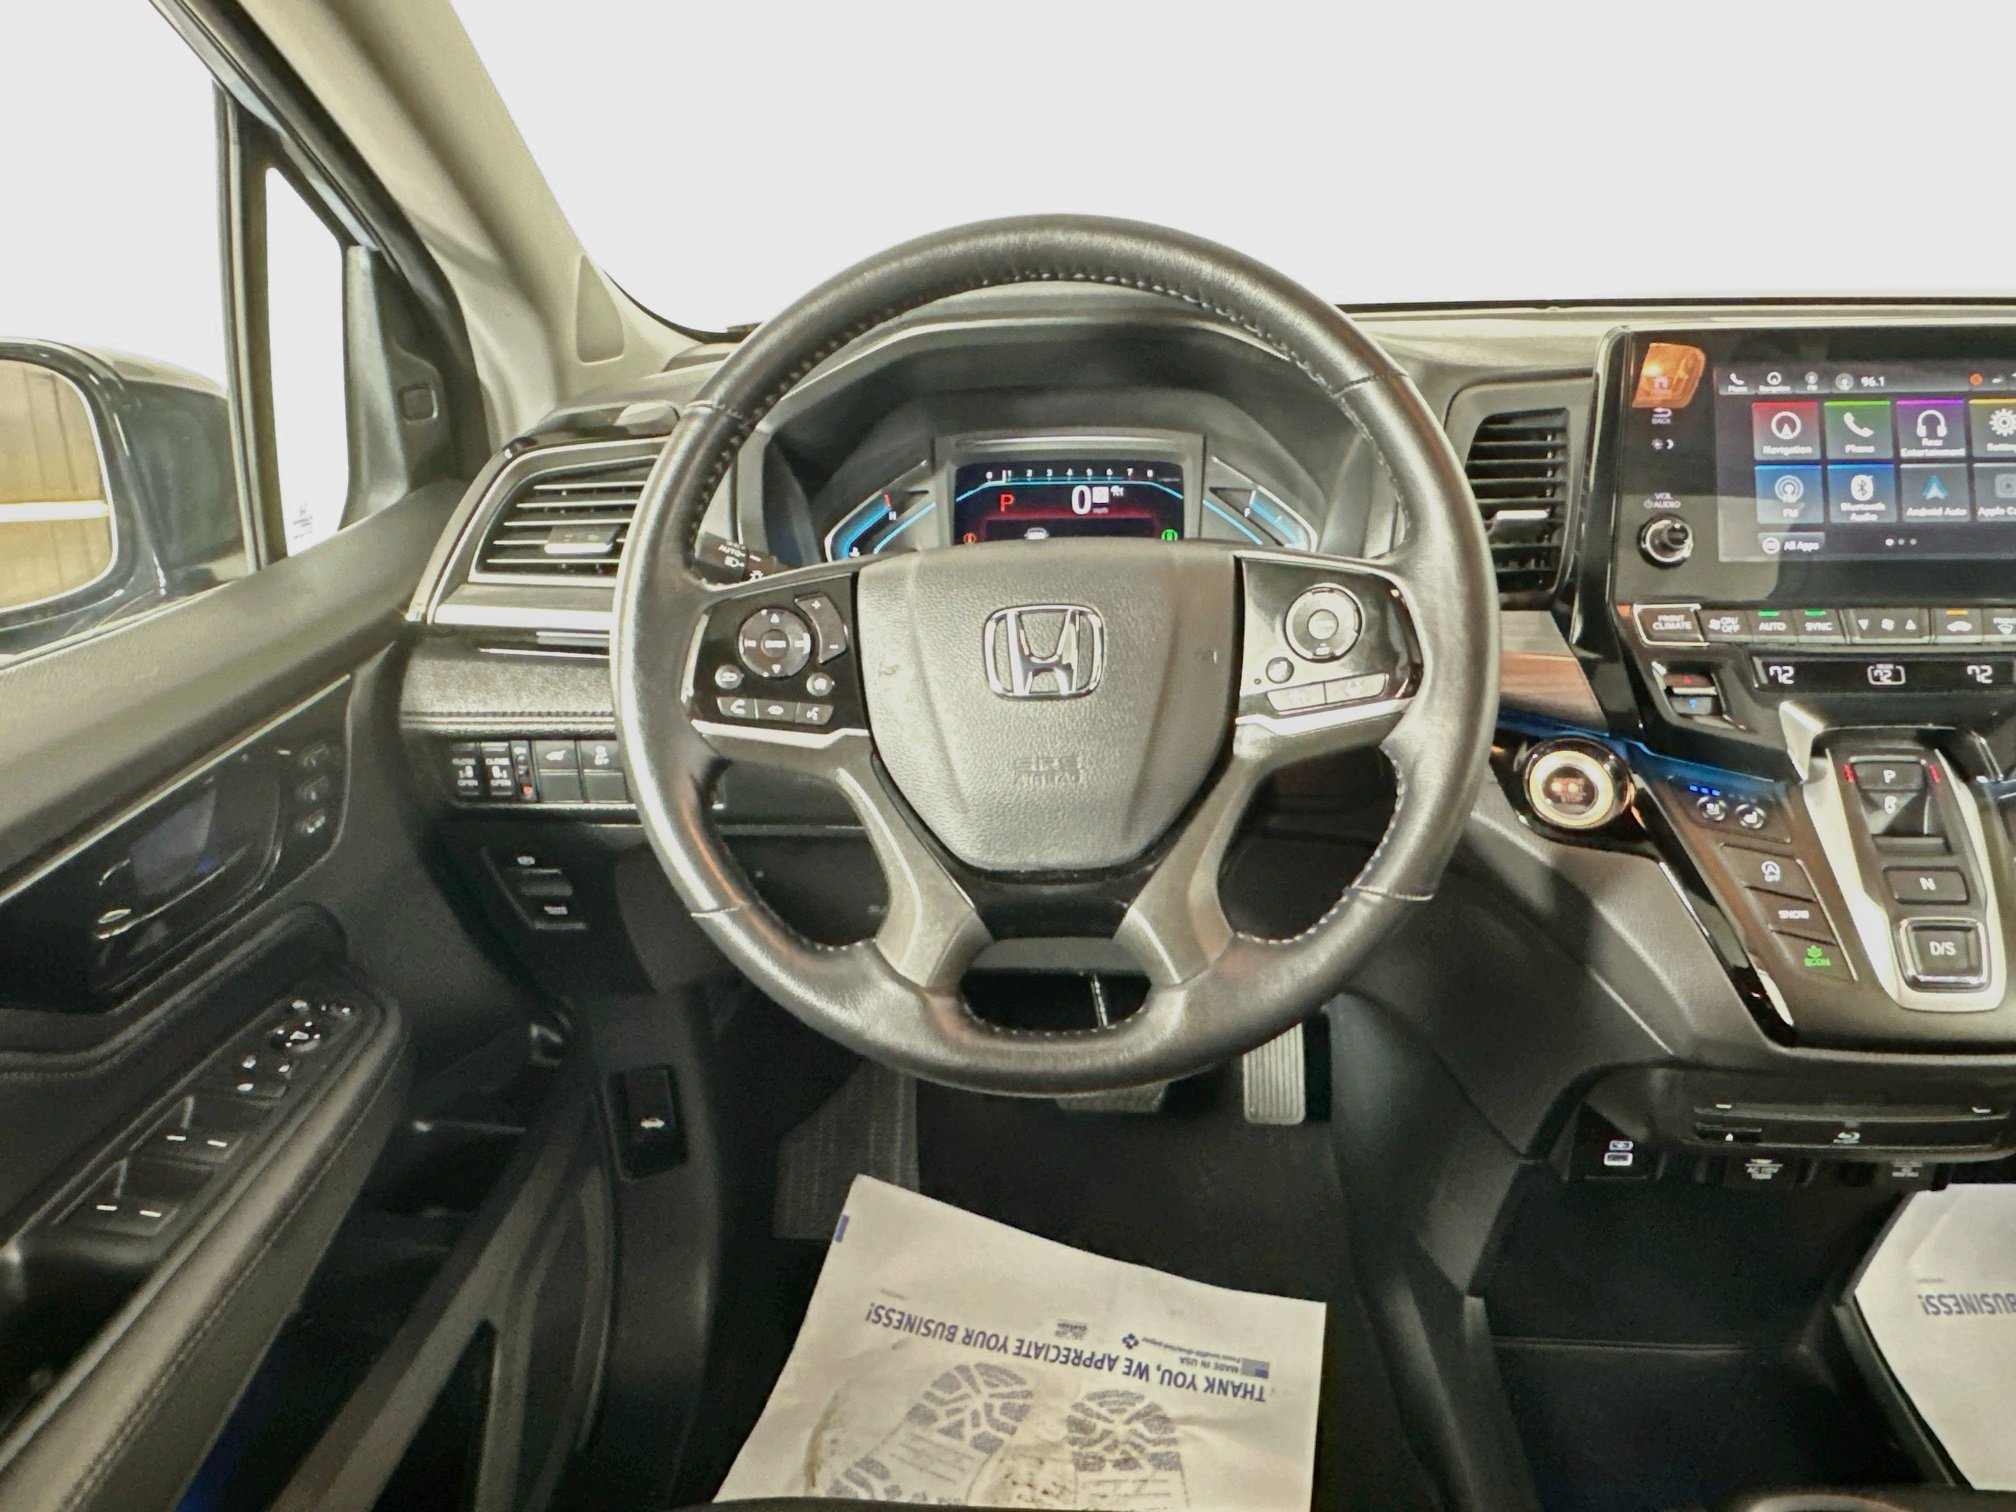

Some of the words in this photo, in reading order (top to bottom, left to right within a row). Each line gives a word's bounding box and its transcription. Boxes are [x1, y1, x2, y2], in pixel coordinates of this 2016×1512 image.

[1861, 376, 1885, 387] 96.1
[1762, 445, 1812, 455] Navigation
[1845, 444, 1875, 453] Phone
[1901, 447, 1965, 457] Entertainment
[1000, 493, 1015, 512] P
[1071, 485, 1092, 515] 0
[1653, 501, 1682, 509] AUDIO
[1840, 502, 1886, 511] Bluetooth
[1906, 507, 1943, 516] Android
[1944, 507, 1967, 516] Auto
[1977, 507, 2005, 517] Apple
[1850, 513, 1878, 521] Audio
[1784, 541, 1796, 551] All
[1797, 541, 1820, 552] Apps
[1652, 622, 1692, 630] CLIMATE
[1758, 622, 1786, 631] AUTO
[1804, 621, 1834, 631] SYNC
[1769, 665, 1795, 685] 72
[1967, 665, 1993, 684] 72
[1884, 769, 1896, 783] P
[1919, 876, 1936, 891] N
[1929, 941, 1956, 956] D/S
[1804, 957, 1831, 967] ECON
[865, 1302, 959, 1343] BUSINESS!
[962, 1327, 1009, 1354] YOUR
[1012, 1338, 1120, 1372] APPRECIATE
[1179, 1356, 1198, 1367] USA
[1200, 1359, 1211, 1369] IN
[1122, 1358, 1150, 1382] WE
[1213, 1361, 1239, 1374] MADE
[1155, 1363, 1197, 1391] YOU,
[1203, 1376, 1266, 1402] THANK
